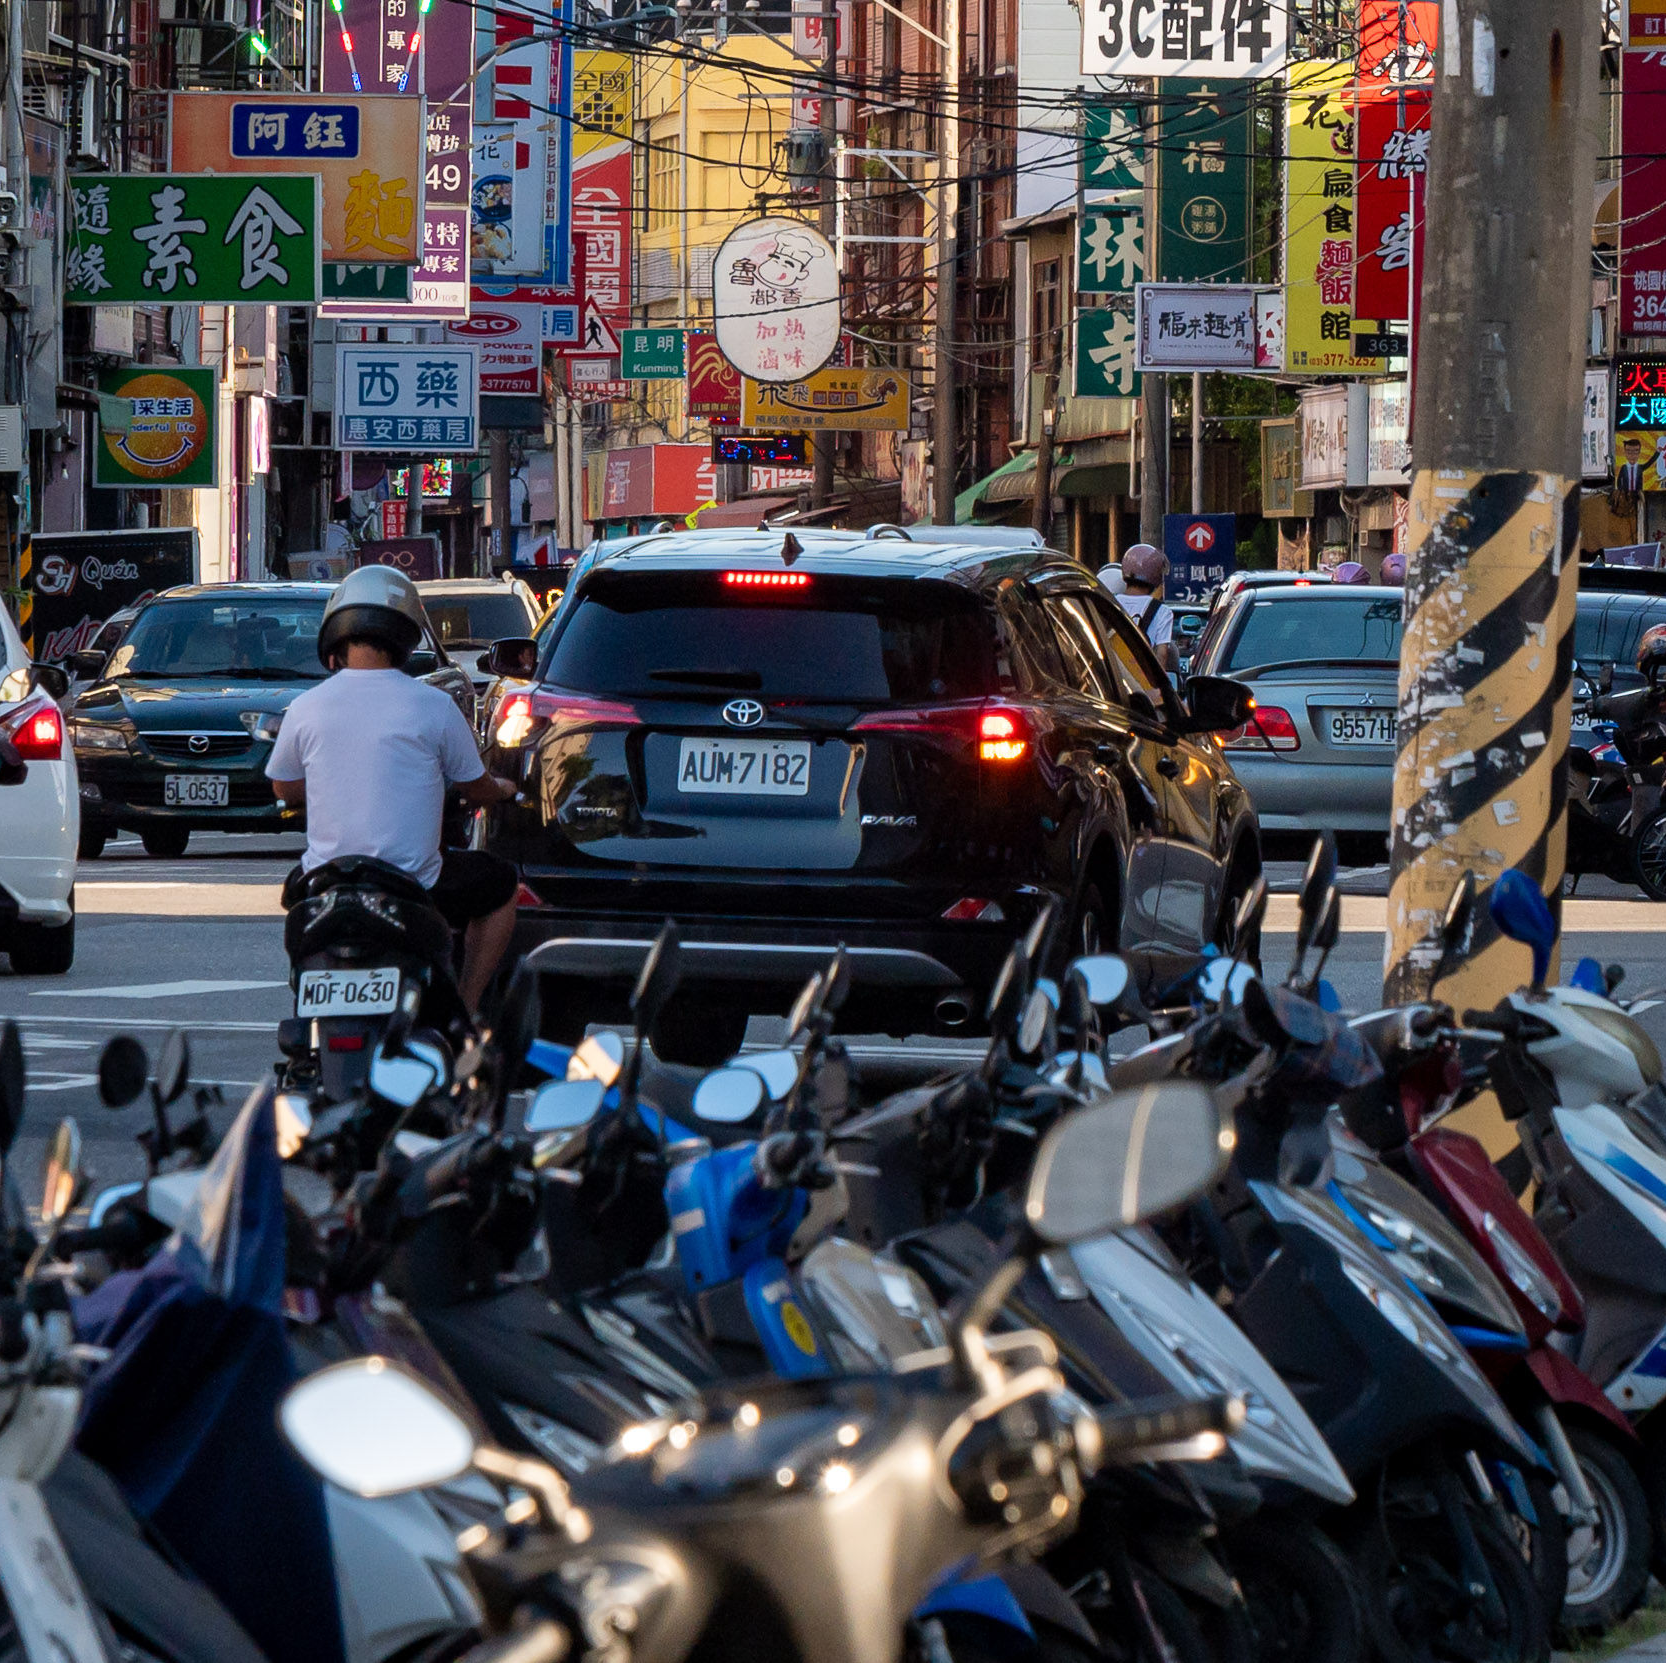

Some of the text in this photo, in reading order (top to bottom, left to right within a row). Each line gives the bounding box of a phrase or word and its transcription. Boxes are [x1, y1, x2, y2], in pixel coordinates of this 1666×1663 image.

[246, 111, 347, 152] 阿鈺
[343, 168, 413, 256] 麵
[65, 184, 113, 297] 隨緣
[132, 184, 305, 293] 素食
[634, 335, 675, 353] 昆明
[755, 317, 806, 342] 加熱
[357, 361, 461, 410] 西藥
[633, 362, 680, 375] Kunming
[348, 418, 467, 442] 惠安西藥房
[682, 751, 807, 786] AUM-7182
[576, 806, 618, 818] TOYOTA
[860, 814, 918, 827] RAV4
[300, 972, 399, 1013] MDF-0630
